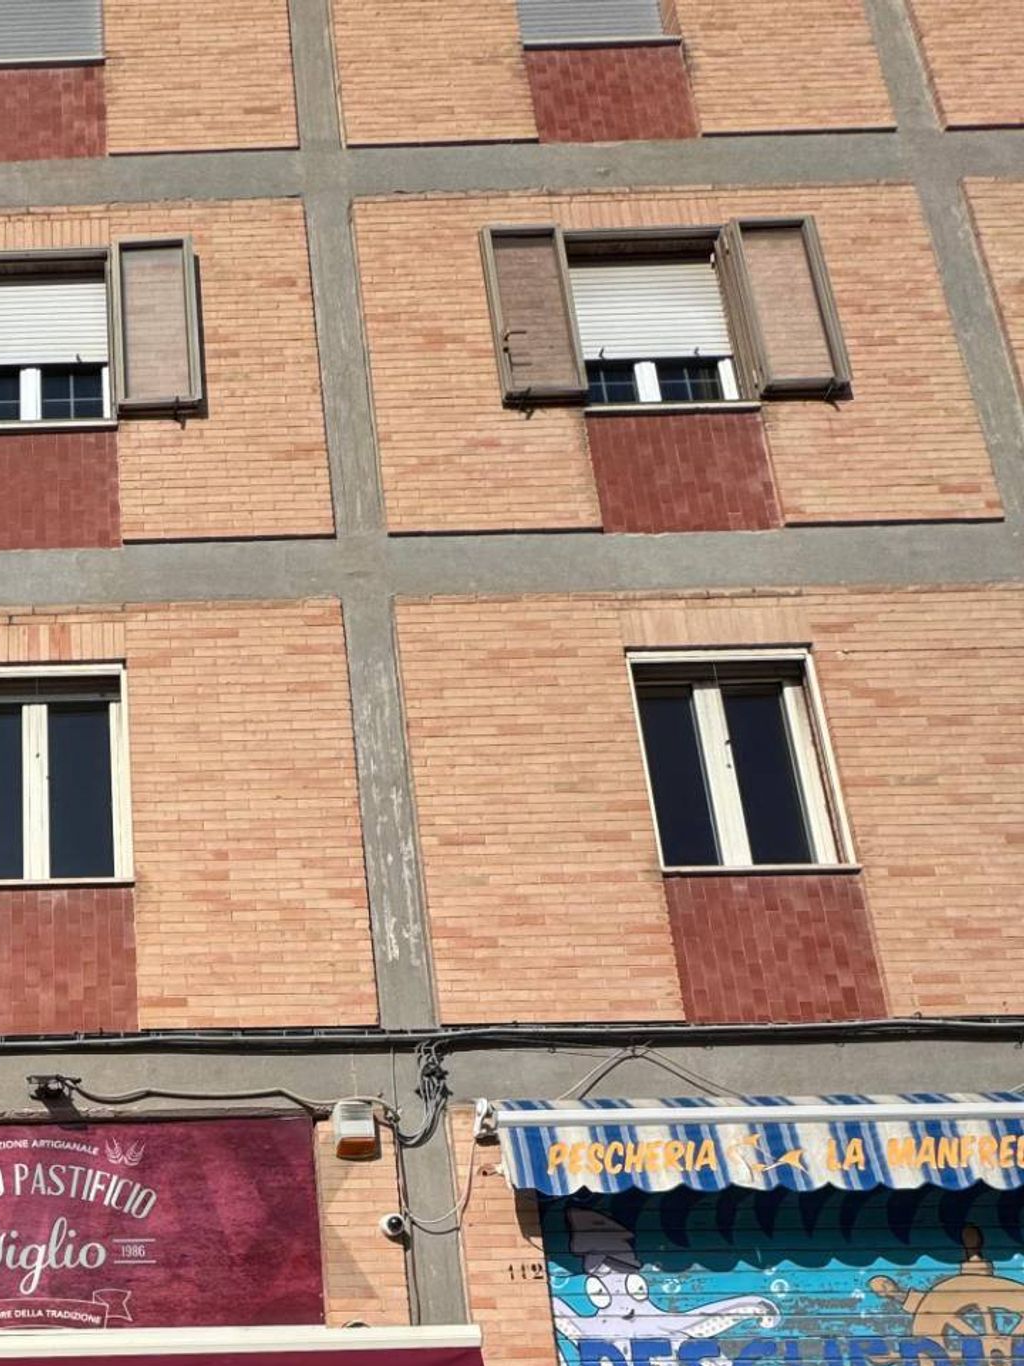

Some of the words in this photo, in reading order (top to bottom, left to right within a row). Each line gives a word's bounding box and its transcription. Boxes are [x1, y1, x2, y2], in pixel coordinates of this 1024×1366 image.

[31, 1139, 100, 1156] ARTIGIANALE
[547, 1137, 718, 1176] PESCHERIA
[826, 1137, 865, 1171] LA
[13, 1162, 158, 1220] PASTIFICIO
[120, 1244, 147, 1258] 1986
[508, 1263, 544, 1281] 112
[14, 1309, 44, 1319] DELLA
[45, 1309, 102, 1325] TRADIZIONE
